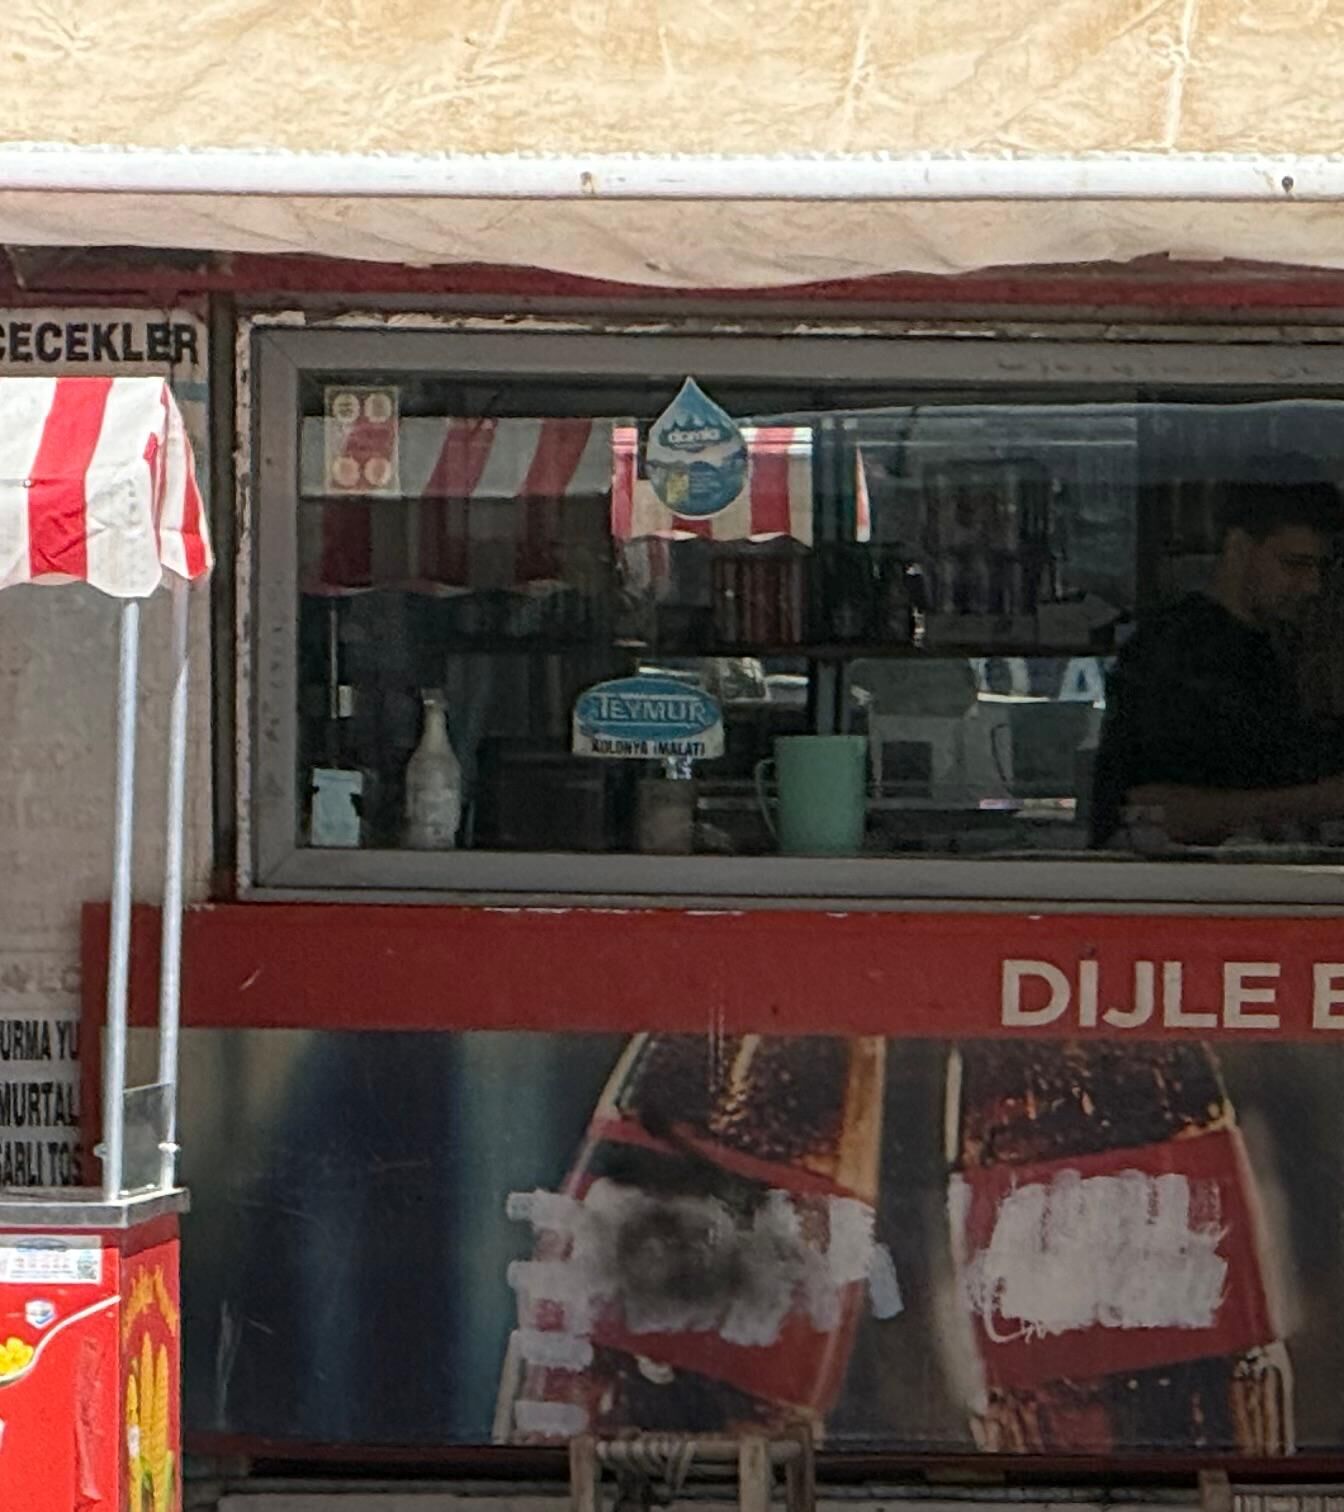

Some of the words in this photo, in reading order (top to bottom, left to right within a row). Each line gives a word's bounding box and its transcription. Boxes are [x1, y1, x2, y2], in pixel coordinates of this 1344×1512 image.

[0, 321, 199, 364] ECEKLER
[588, 693, 706, 724] TEYMUR
[0, 1141, 43, 1187] ARLI
